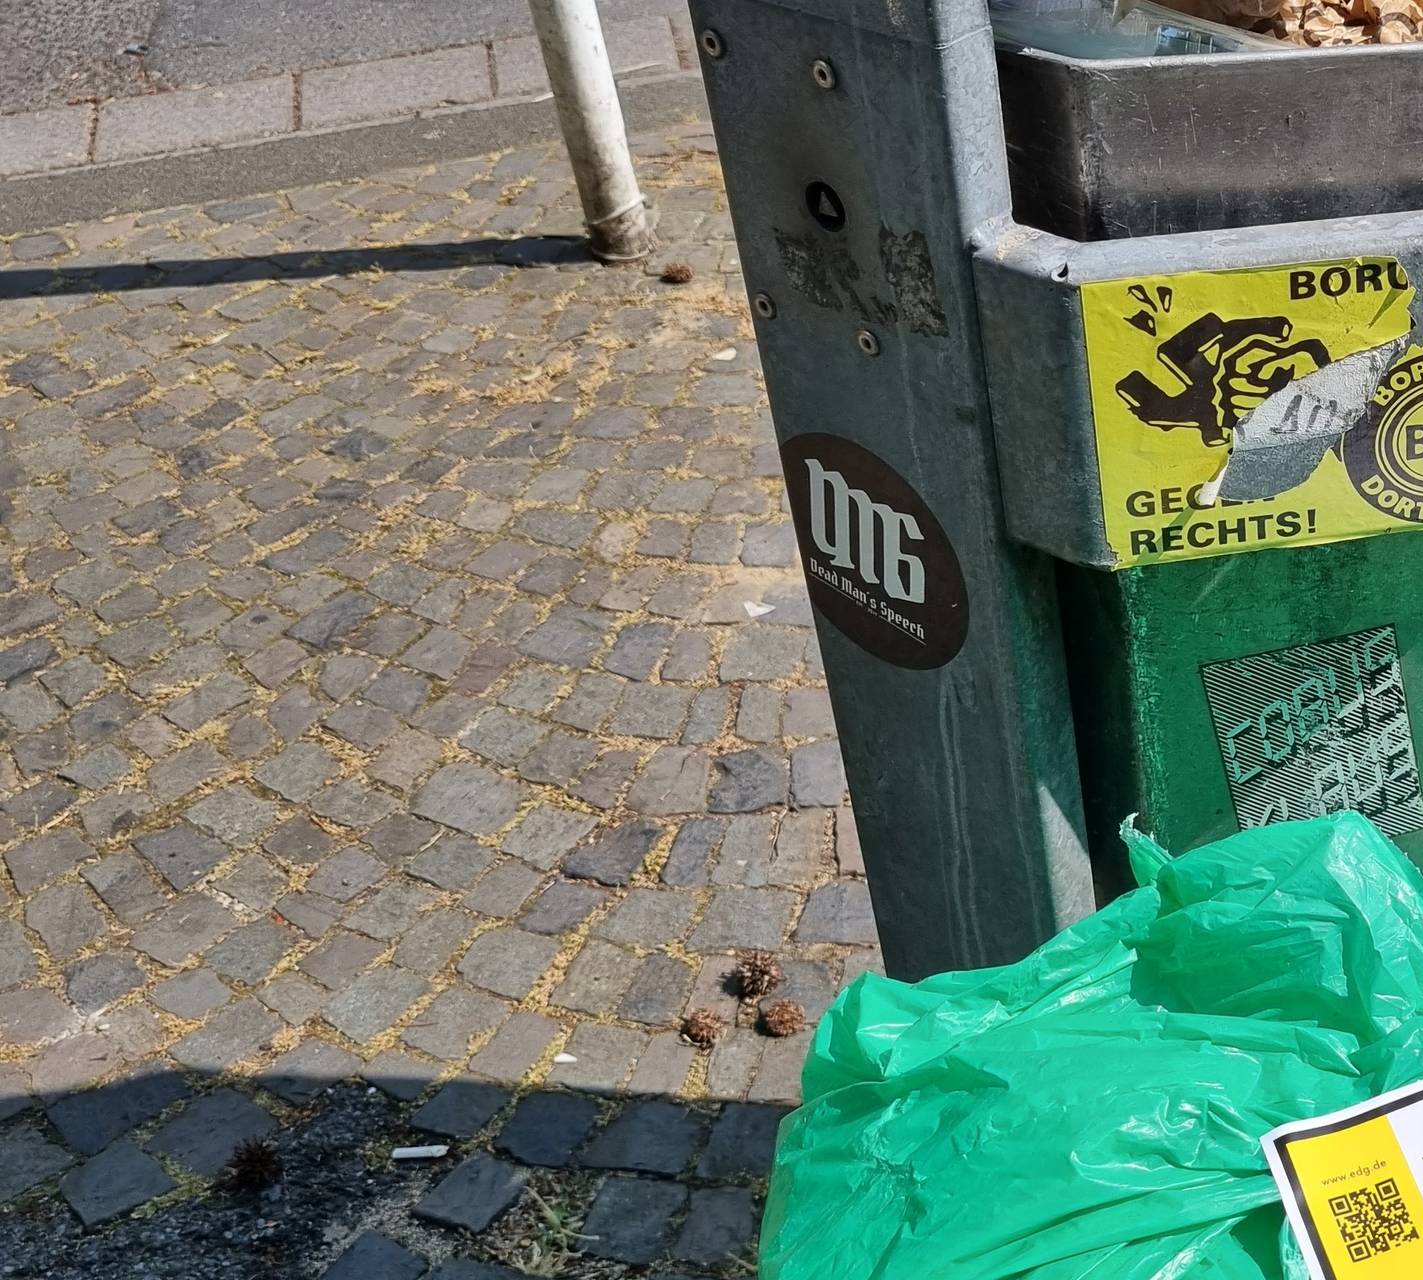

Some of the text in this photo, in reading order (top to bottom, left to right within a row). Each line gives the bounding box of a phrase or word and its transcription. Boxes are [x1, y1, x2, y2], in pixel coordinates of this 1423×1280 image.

[1130, 508, 1316, 556] RECHTS!
[809, 557, 839, 588] Dead
[880, 601, 925, 640] Speech
[1321, 1159, 1387, 1186] www.edg.de
